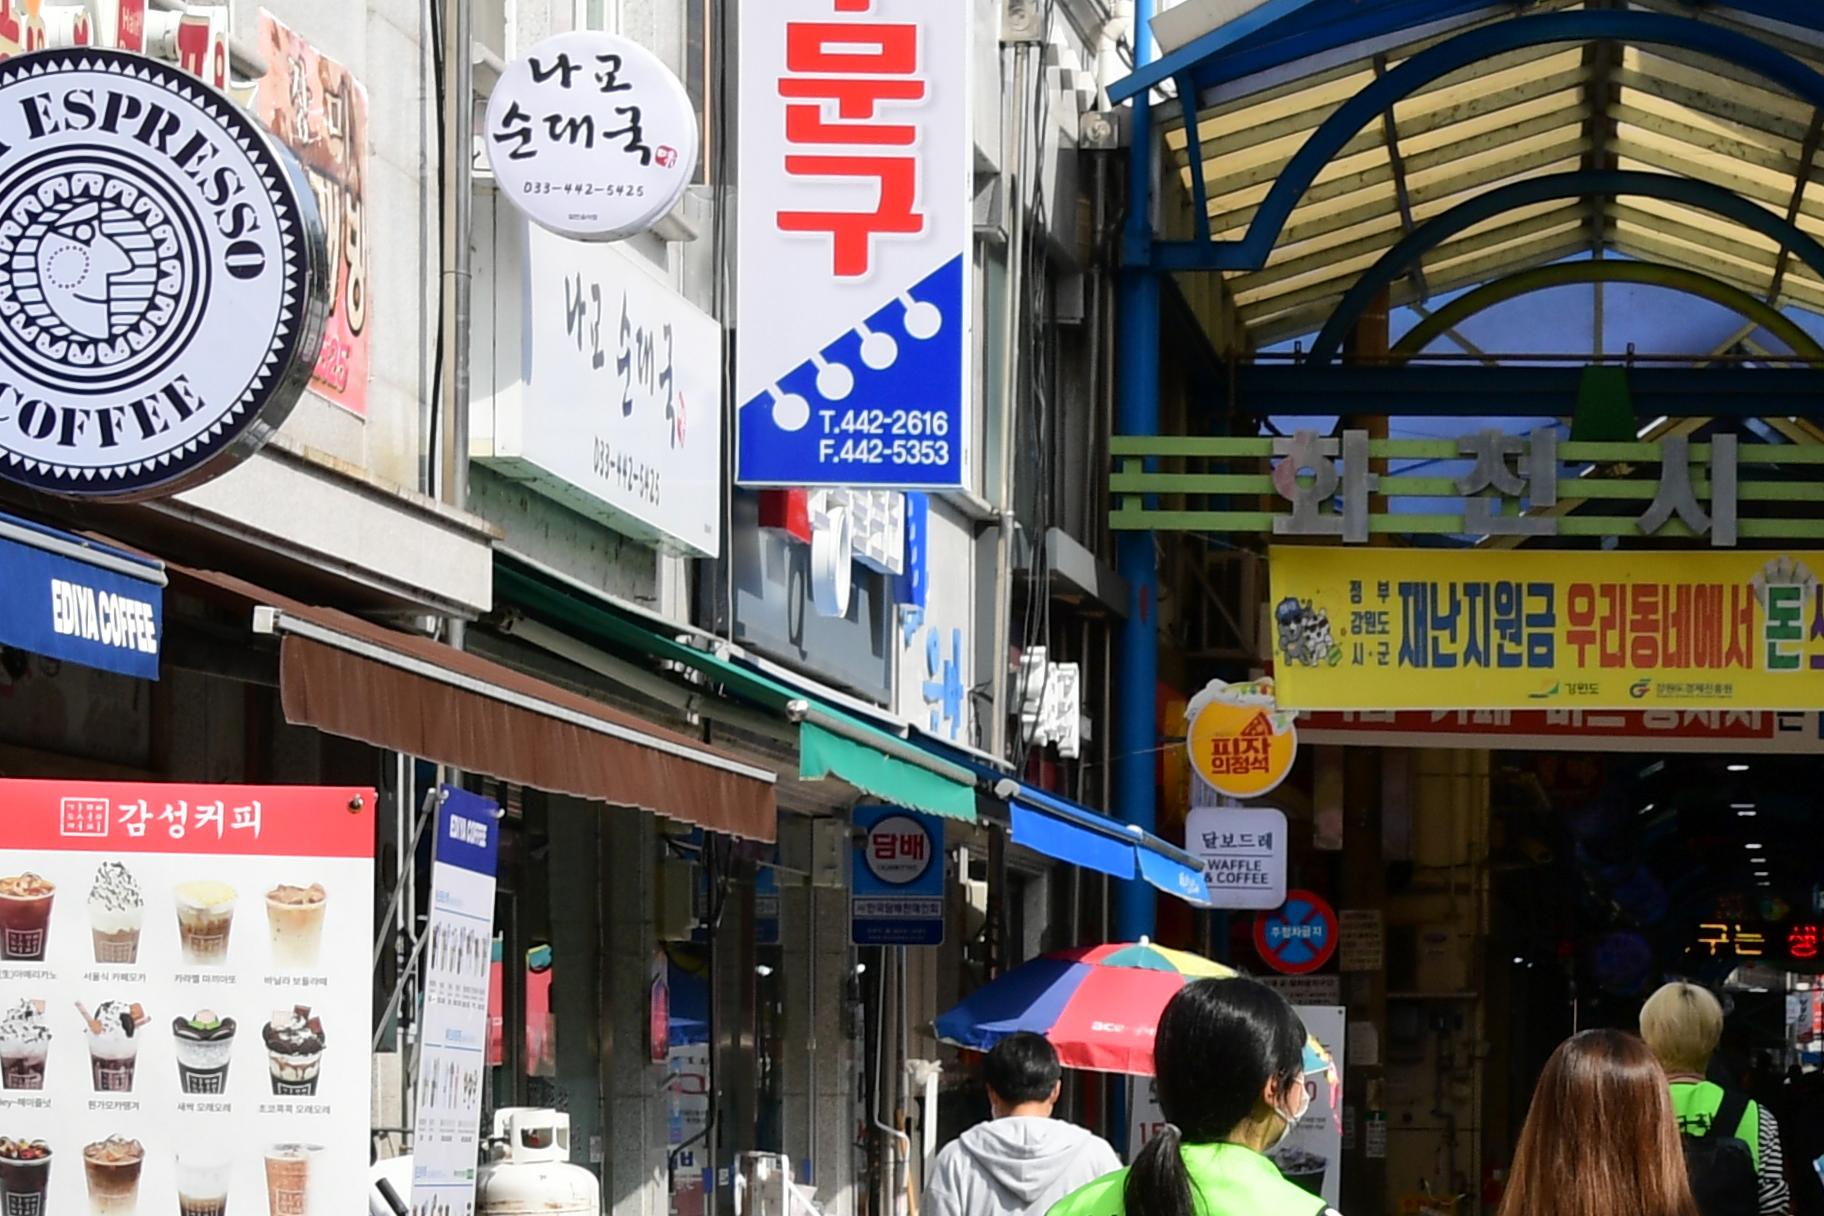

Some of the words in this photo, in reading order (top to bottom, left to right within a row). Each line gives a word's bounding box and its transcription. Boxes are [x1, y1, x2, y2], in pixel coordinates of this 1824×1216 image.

[493, 101, 652, 166] 순대국
[20, 89, 266, 280] ESPRESSO
[522, 181, 646, 197] 033-442-5425
[819, 411, 949, 434] T.442-2616
[819, 440, 950, 465] F.442-5353
[593, 435, 661, 506] 033-442-5425
[51, 578, 100, 641] EDIYA
[98, 590, 158, 654] COFFEE
[1350, 611, 1390, 636] 강원도
[1398, 581, 1556, 669] 재난지원금
[1565, 582, 1755, 670] 우리동네에서
[1764, 584, 1802, 671] 돈
[1211, 736, 1272, 757] 피자
[1211, 755, 1270, 775] 의정석
[117, 799, 263, 840] 감성커피
[873, 833, 924, 860] 담배
[1201, 831, 1274, 851] 달보드레
[1207, 859, 1262, 873] WAFFLE
[1216, 873, 1269, 885] COFFEE
